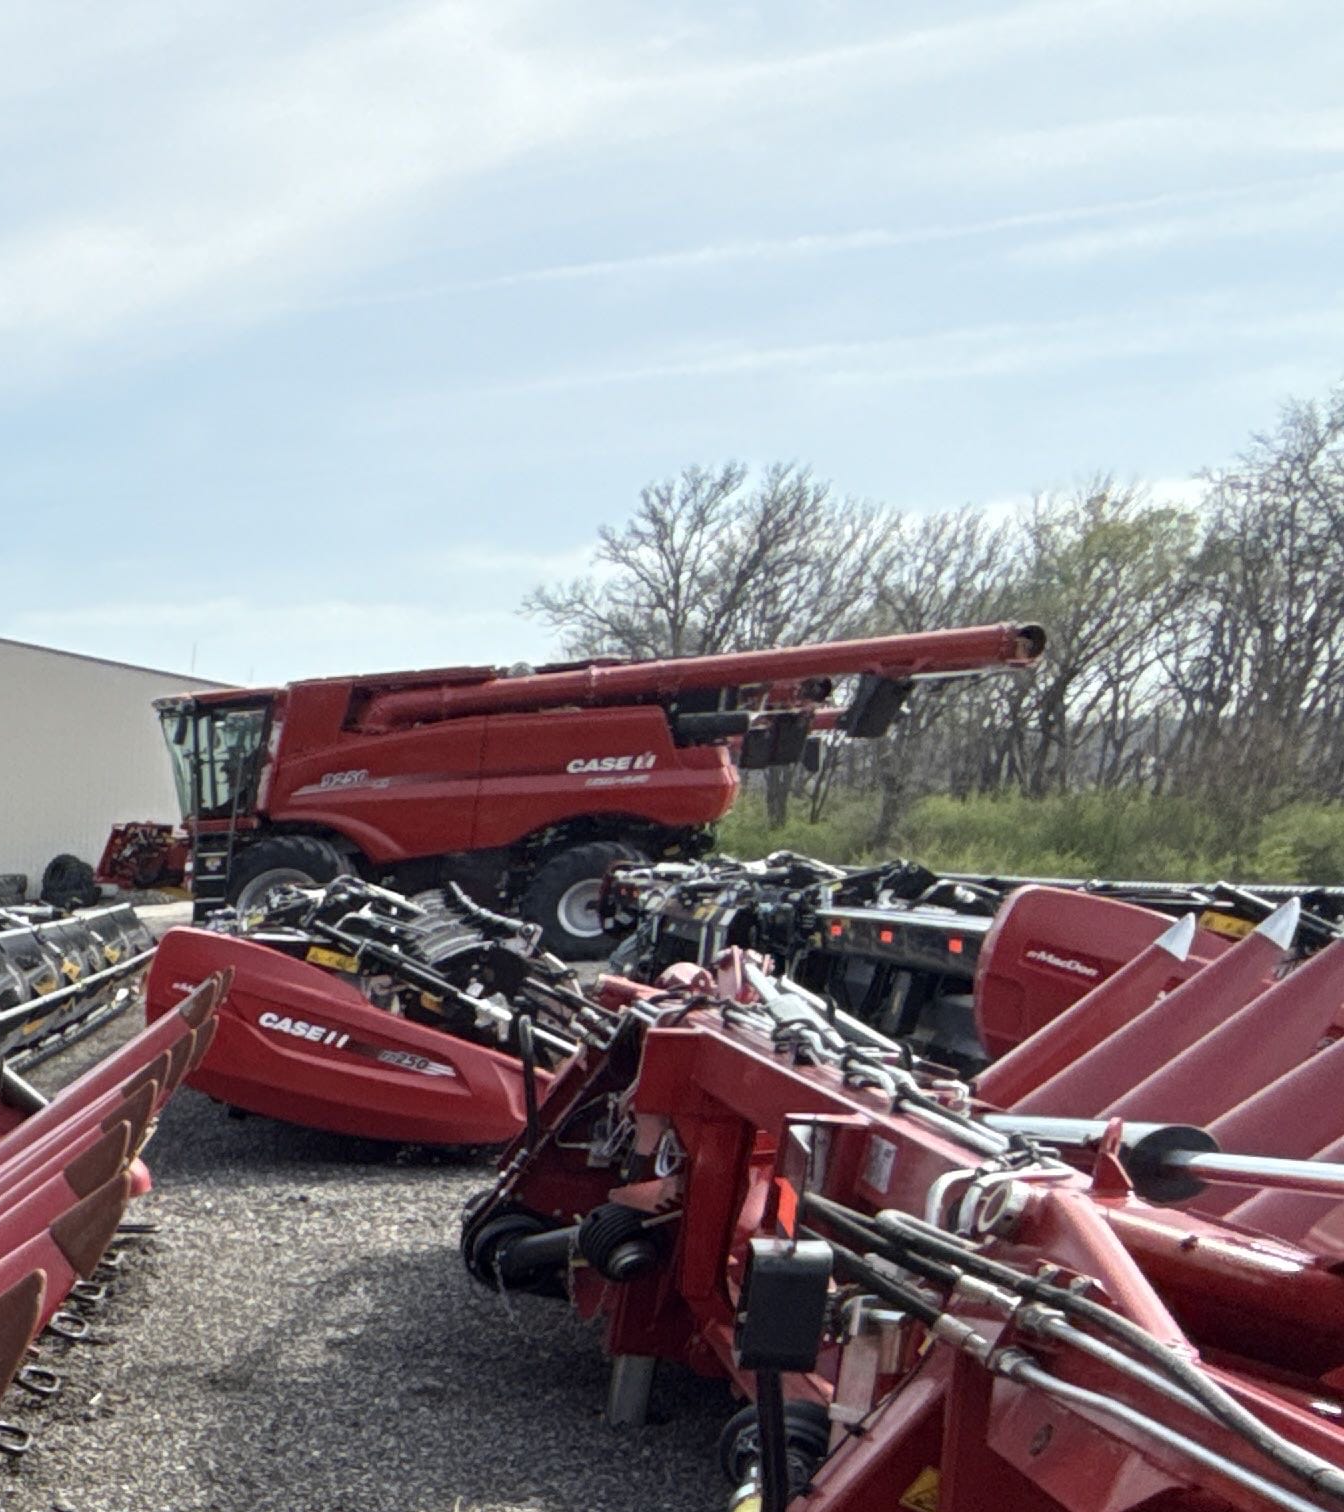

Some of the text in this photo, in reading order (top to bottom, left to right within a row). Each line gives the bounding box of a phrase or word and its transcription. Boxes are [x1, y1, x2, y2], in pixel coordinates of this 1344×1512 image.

[566, 755, 633, 773] CASE
[1036, 950, 1098, 977] MacDon
[258, 1012, 325, 1043] CASE
